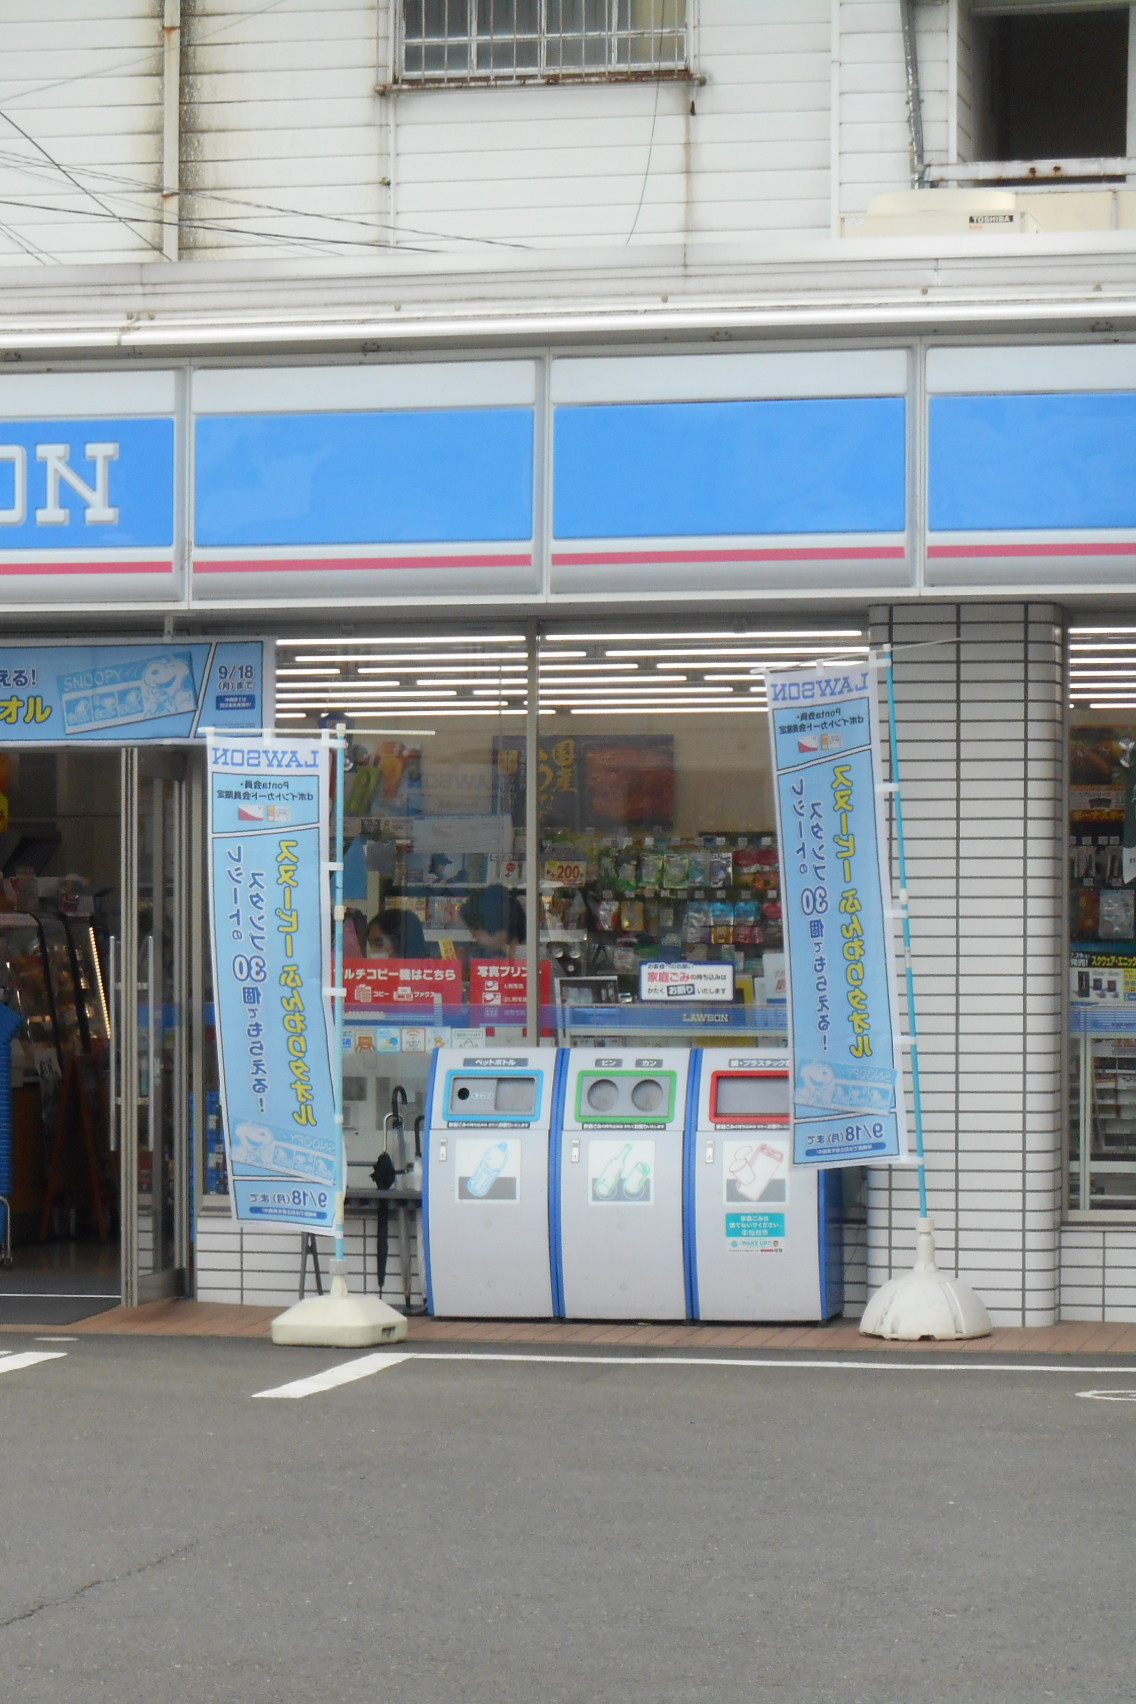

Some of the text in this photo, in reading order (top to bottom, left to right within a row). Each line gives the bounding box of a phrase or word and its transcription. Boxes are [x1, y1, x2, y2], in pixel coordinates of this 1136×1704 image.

[972, 215, 1010, 223] TOSHIBA
[218, 664, 255, 680] 9/18
[64, 666, 123, 692] SNOOPY
[333, 968, 456, 981] ルチコピー機はこちら
[477, 965, 542, 978] 写真プリン
[682, 1013, 729, 1022] LAWSON
[642, 1059, 657, 1067] カン
